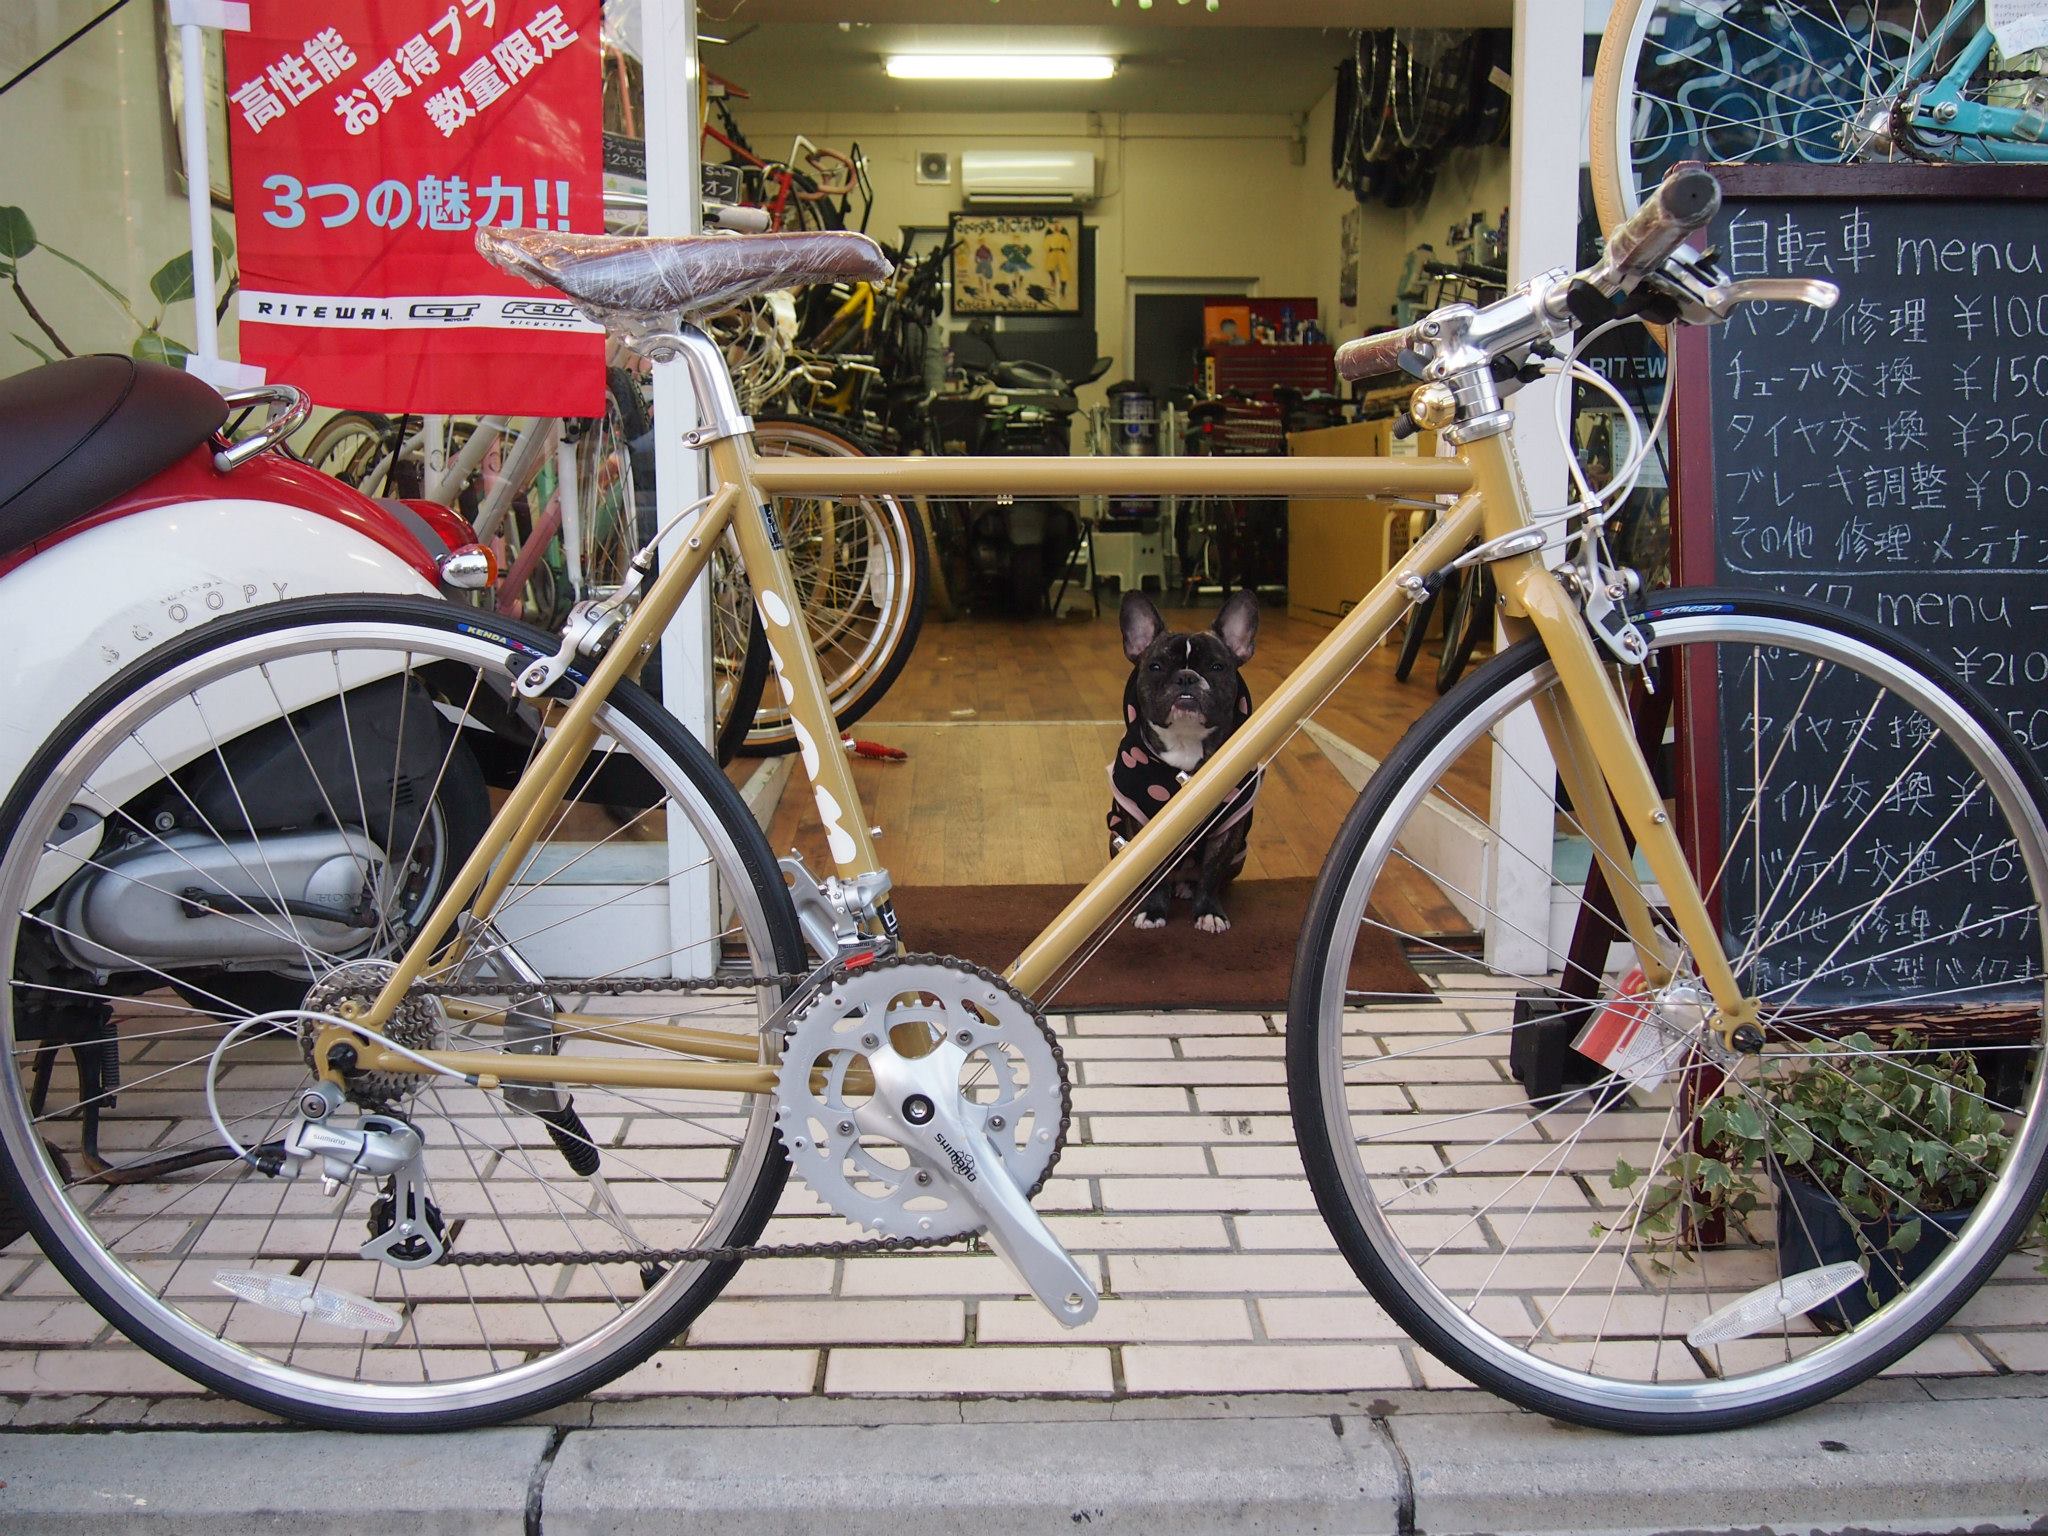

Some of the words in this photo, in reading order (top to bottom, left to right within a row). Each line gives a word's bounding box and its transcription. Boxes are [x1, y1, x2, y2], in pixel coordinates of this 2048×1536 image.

[230, 27, 357, 134] 高性能
[423, 4, 579, 138] 数量限定
[1729, 206, 1876, 276] 自転車
[1896, 237, 2043, 276] menu
[1726, 350, 1923, 400] チューブ交換
[1727, 410, 1929, 457] タイヤ交換
[1726, 461, 1947, 509] ブレーキ調整
[1877, 592, 2012, 628] menu
[466, 625, 508, 645] KENDA
[1739, 709, 1937, 753] タイヤ交換
[1736, 771, 1936, 823] オイル交換
[934, 1133, 977, 1182] SHIMANO
